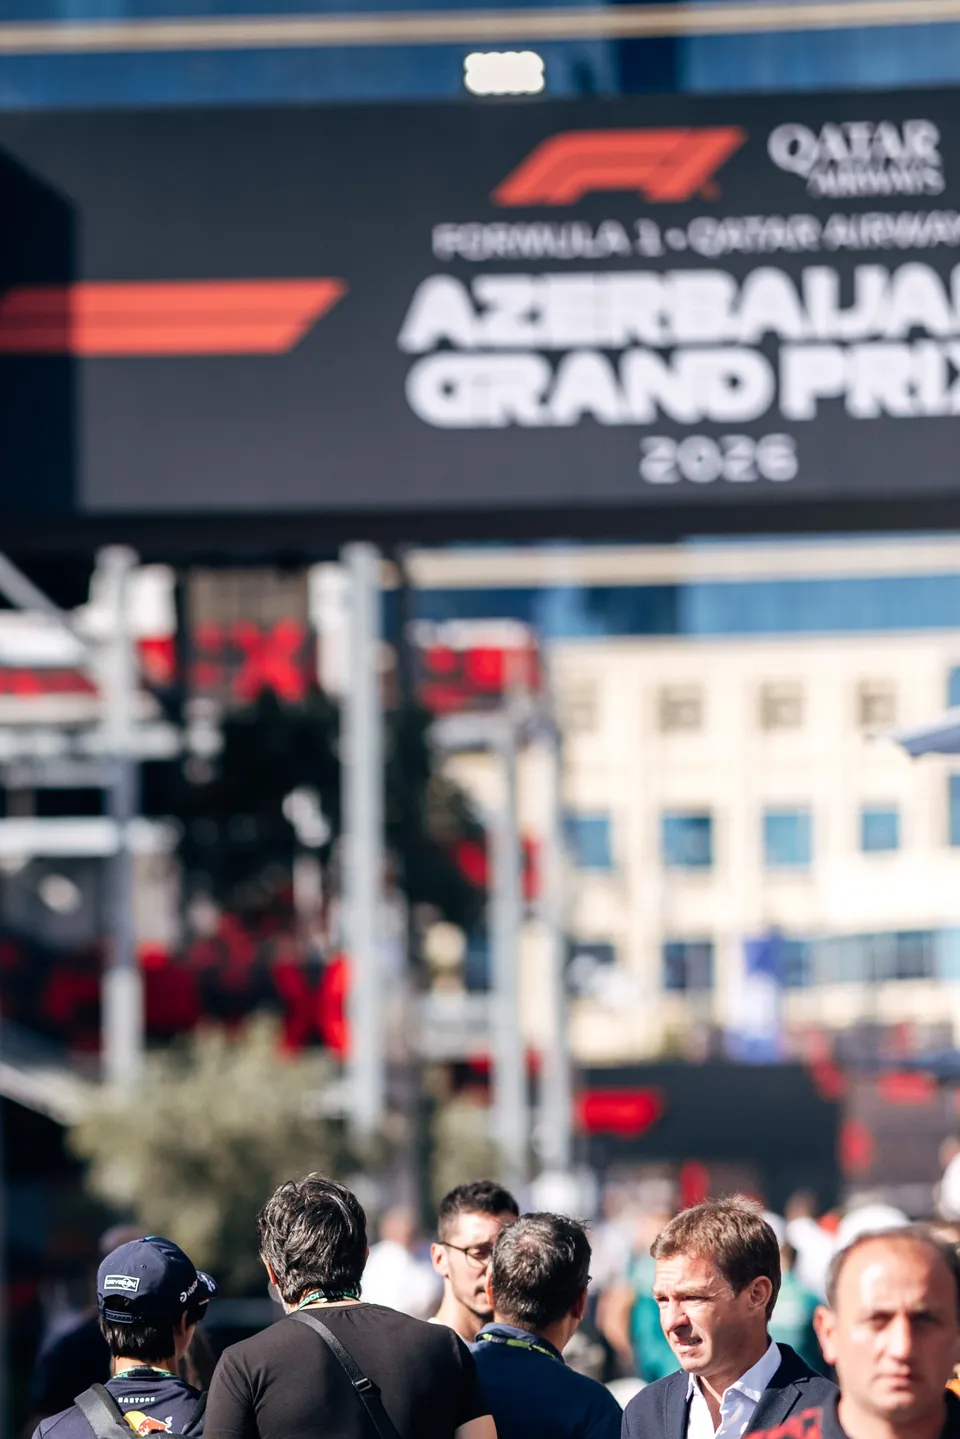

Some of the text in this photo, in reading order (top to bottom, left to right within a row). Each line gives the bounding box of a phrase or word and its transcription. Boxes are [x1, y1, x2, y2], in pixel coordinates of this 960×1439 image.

[397, 261, 960, 353] AZERBAIJA
[405, 346, 776, 428] GRAND
[639, 433, 799, 484] 2026
